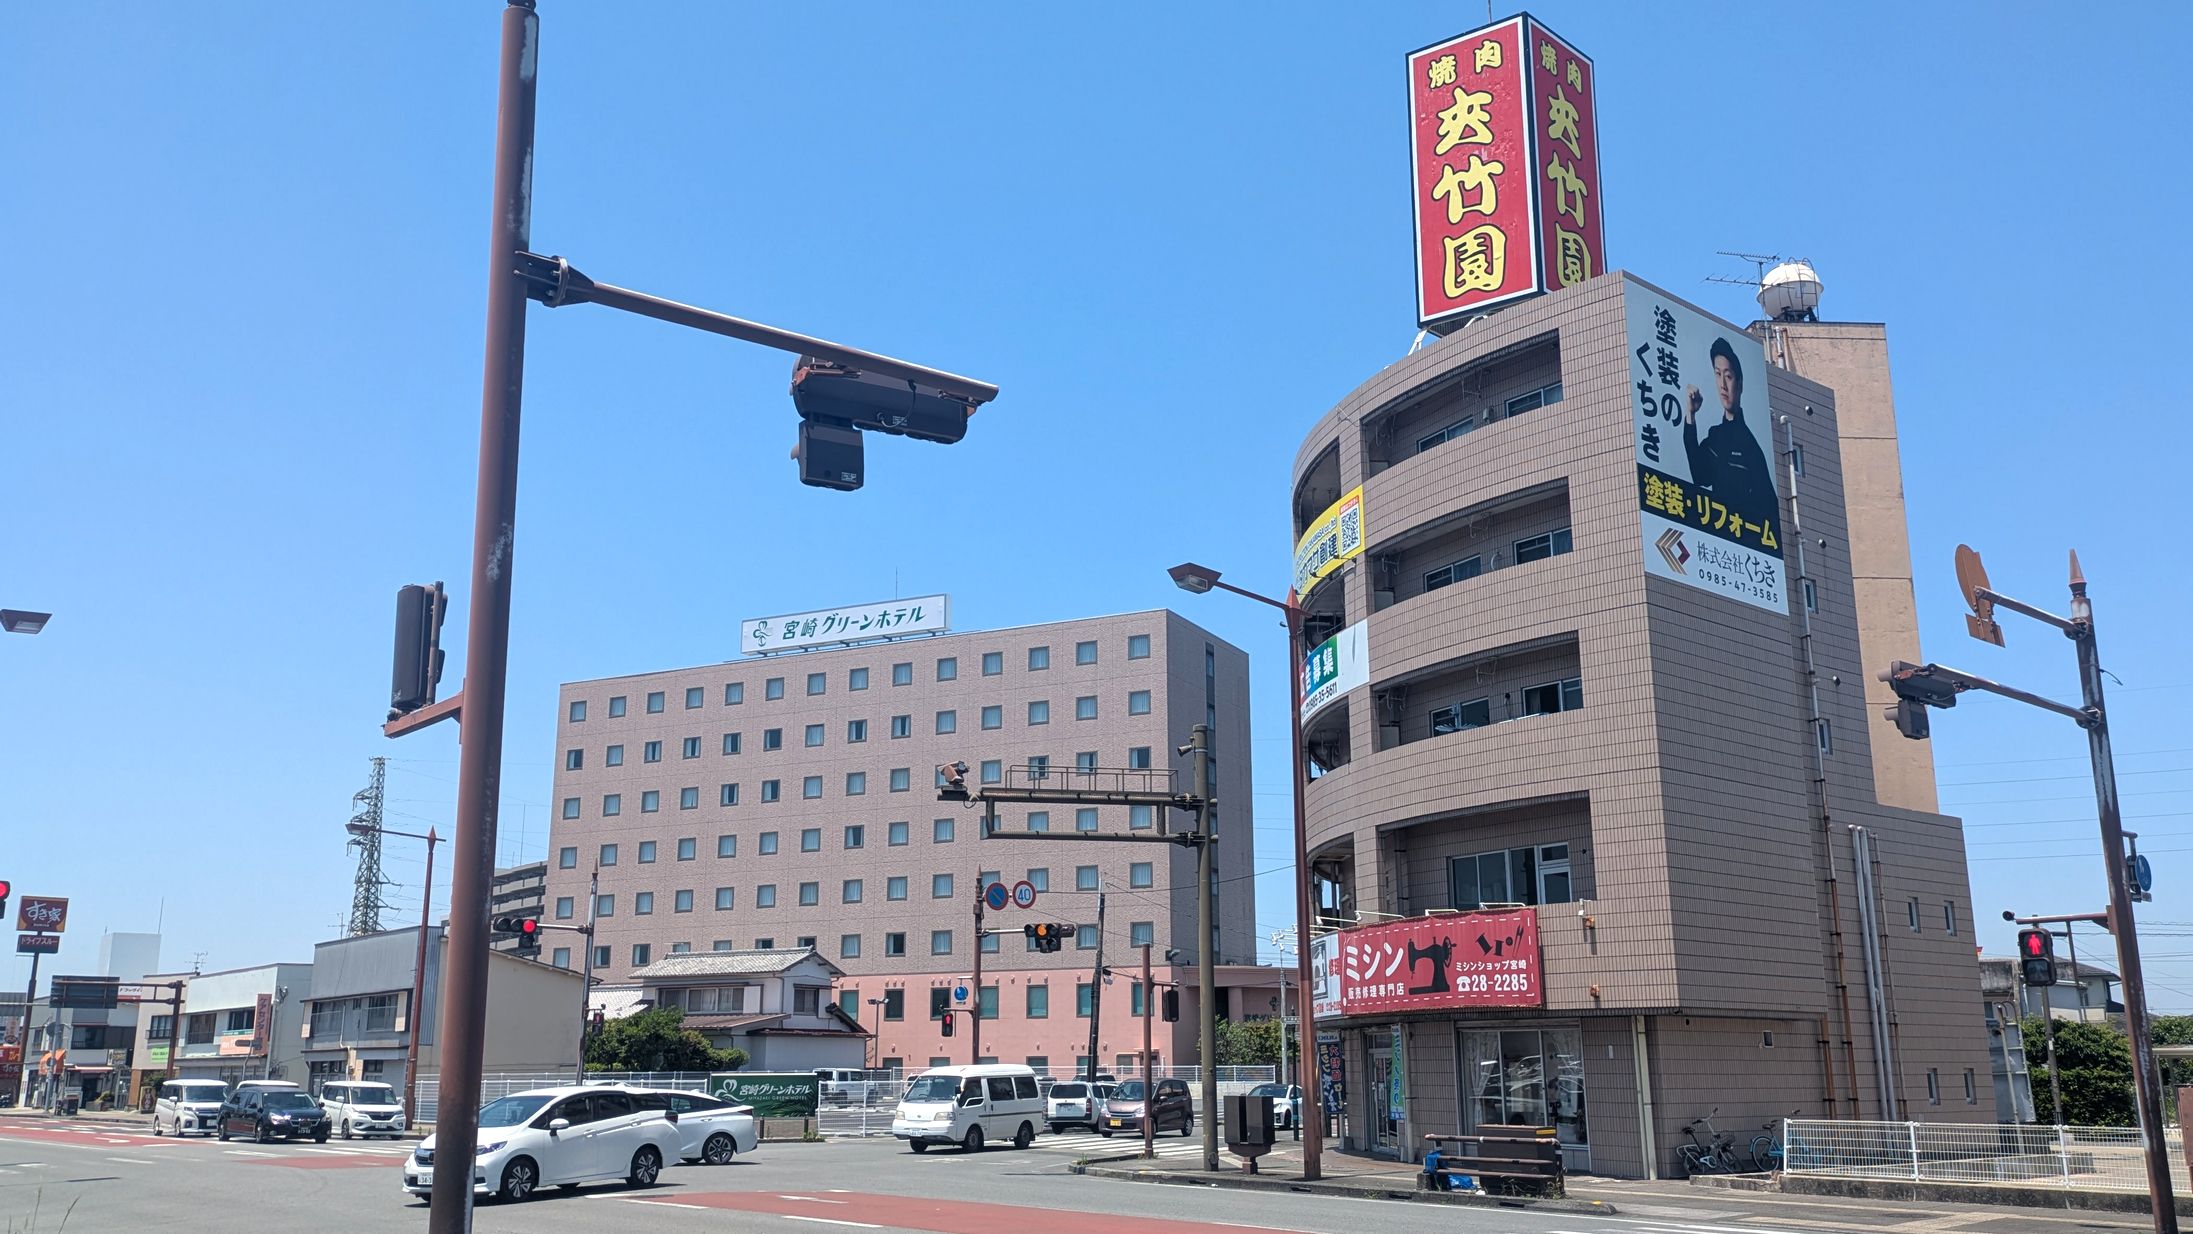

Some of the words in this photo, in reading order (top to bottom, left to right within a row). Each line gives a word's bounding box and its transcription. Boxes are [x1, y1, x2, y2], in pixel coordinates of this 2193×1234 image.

[1429, 40, 1503, 88] 焼肉
[1540, 40, 1582, 93] 焼肉
[1654, 305, 1682, 427] 塗装の
[1636, 342, 1660, 463] くちき
[1644, 472, 1778, 550] 塗装・リフォーム
[1697, 540, 1776, 588] 株式会社くちき
[1699, 568, 1778, 603] 0985-47-3585
[782, 606, 926, 640] 宮崎グリーンホテル
[26, 901, 62, 923] すき家
[1017, 888, 1031, 901] 40
[1346, 942, 1404, 981] ミシン
[1456, 960, 1527, 972] ミシンショップ宮崎
[1348, 983, 1404, 1000] 販売修理専門店
[1472, 974, 1527, 992] 28-2285
[740, 1083, 812, 1095] 宮崎グリーンホテル
